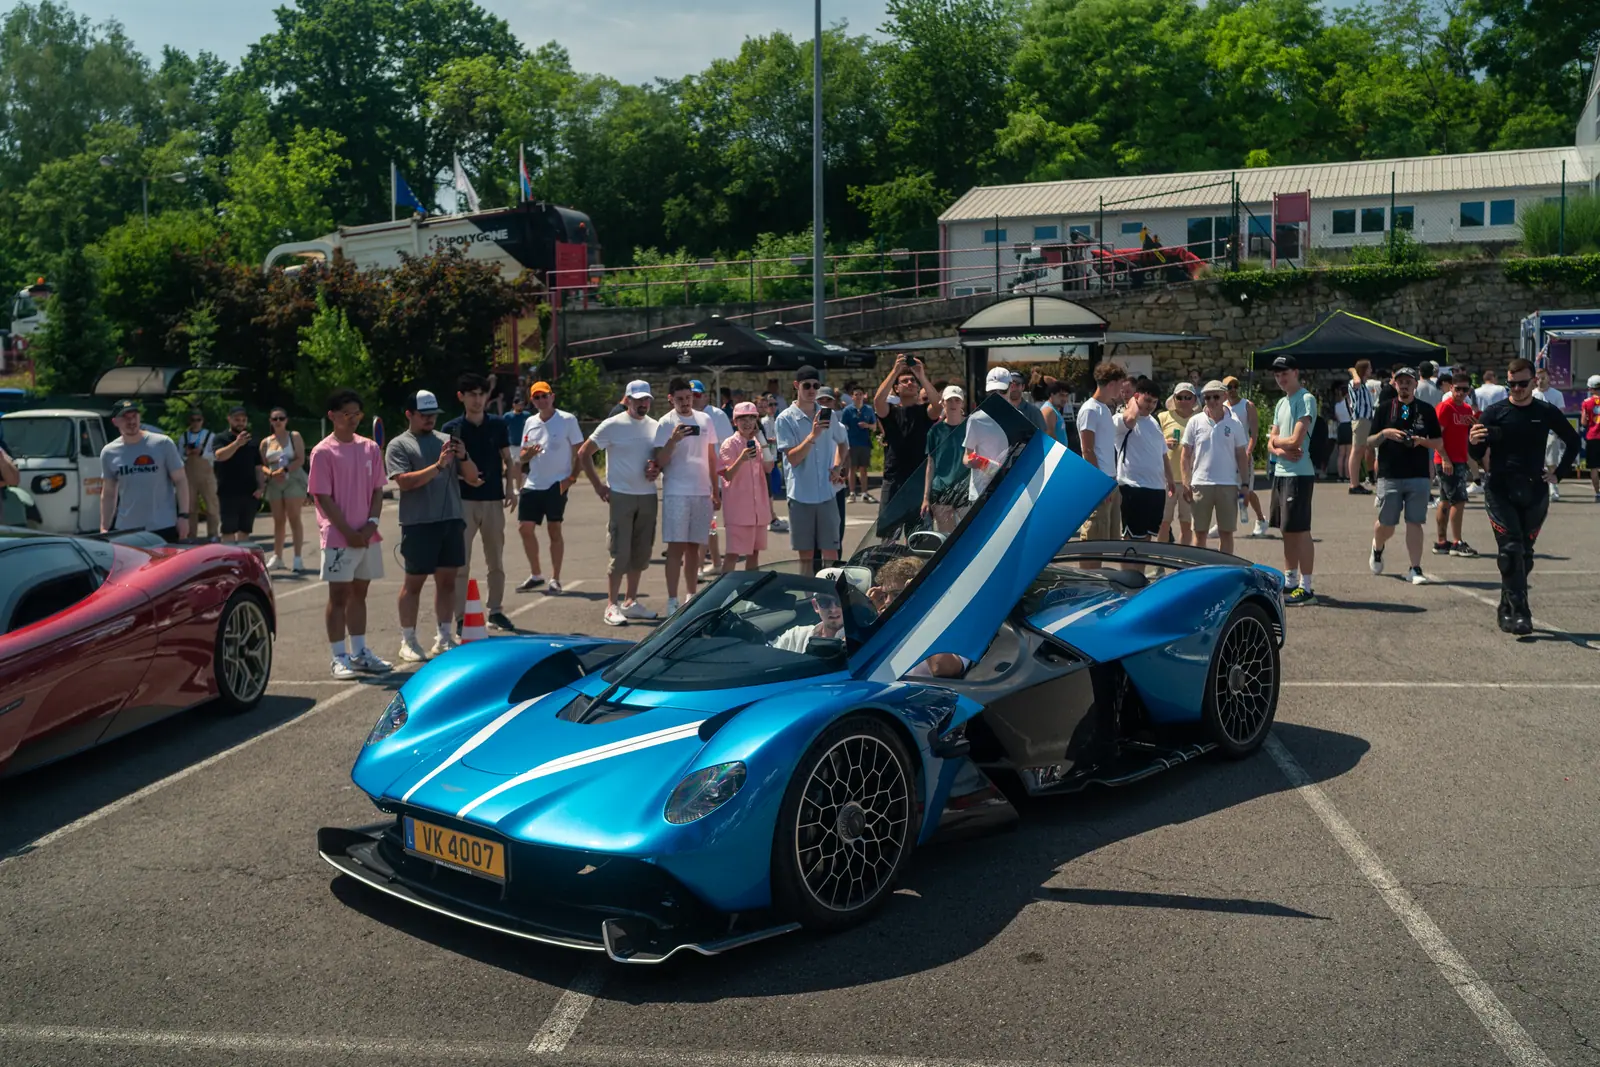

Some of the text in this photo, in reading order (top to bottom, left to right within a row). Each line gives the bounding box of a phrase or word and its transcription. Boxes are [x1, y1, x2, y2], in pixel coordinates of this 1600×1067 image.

[449, 229, 509, 245] POLYGONE
[115, 464, 159, 476] ellesse
[408, 835, 413, 844] L
[423, 825, 494, 869] VK 4007
